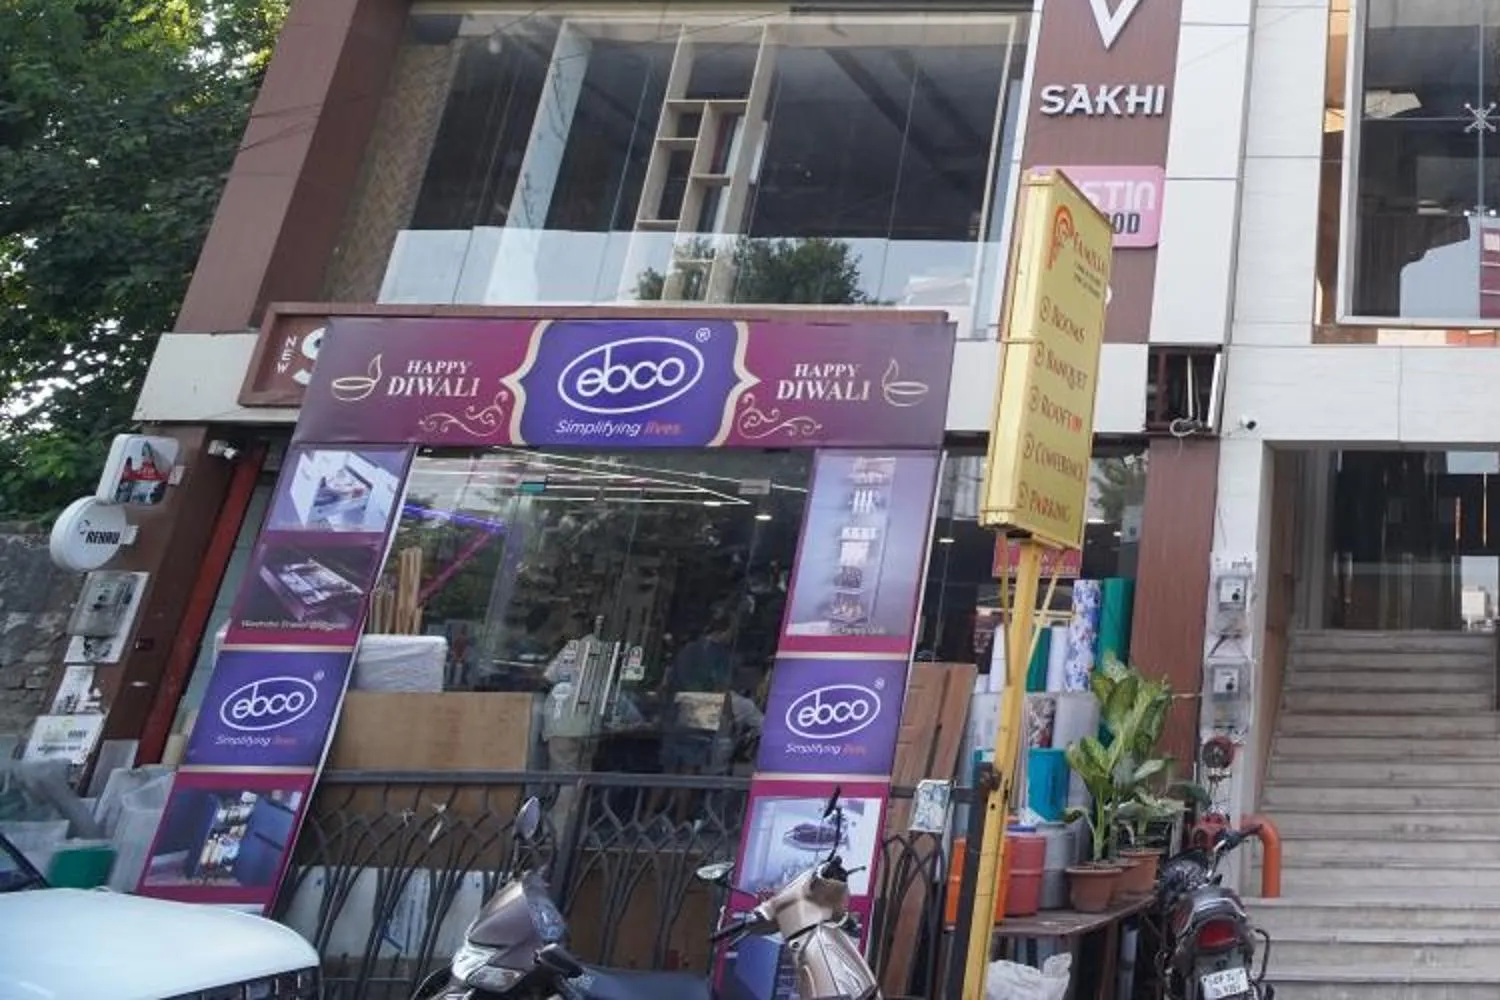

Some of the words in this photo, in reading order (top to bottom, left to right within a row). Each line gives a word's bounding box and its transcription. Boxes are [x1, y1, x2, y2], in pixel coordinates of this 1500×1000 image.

[1039, 83, 1167, 118] SAKHI
[1082, 180, 1157, 211] STIN
[277, 335, 297, 374] NEW
[406, 359, 469, 376] HAPPY
[576, 346, 685, 397] ebco
[794, 362, 858, 379] HAPPY
[387, 376, 480, 398] DIWALI
[776, 378, 871, 401] DIWALI
[555, 418, 641, 437] Simplifying
[85, 530, 121, 545] REHAU
[232, 682, 305, 719] ebco
[797, 690, 869, 727] ebco
